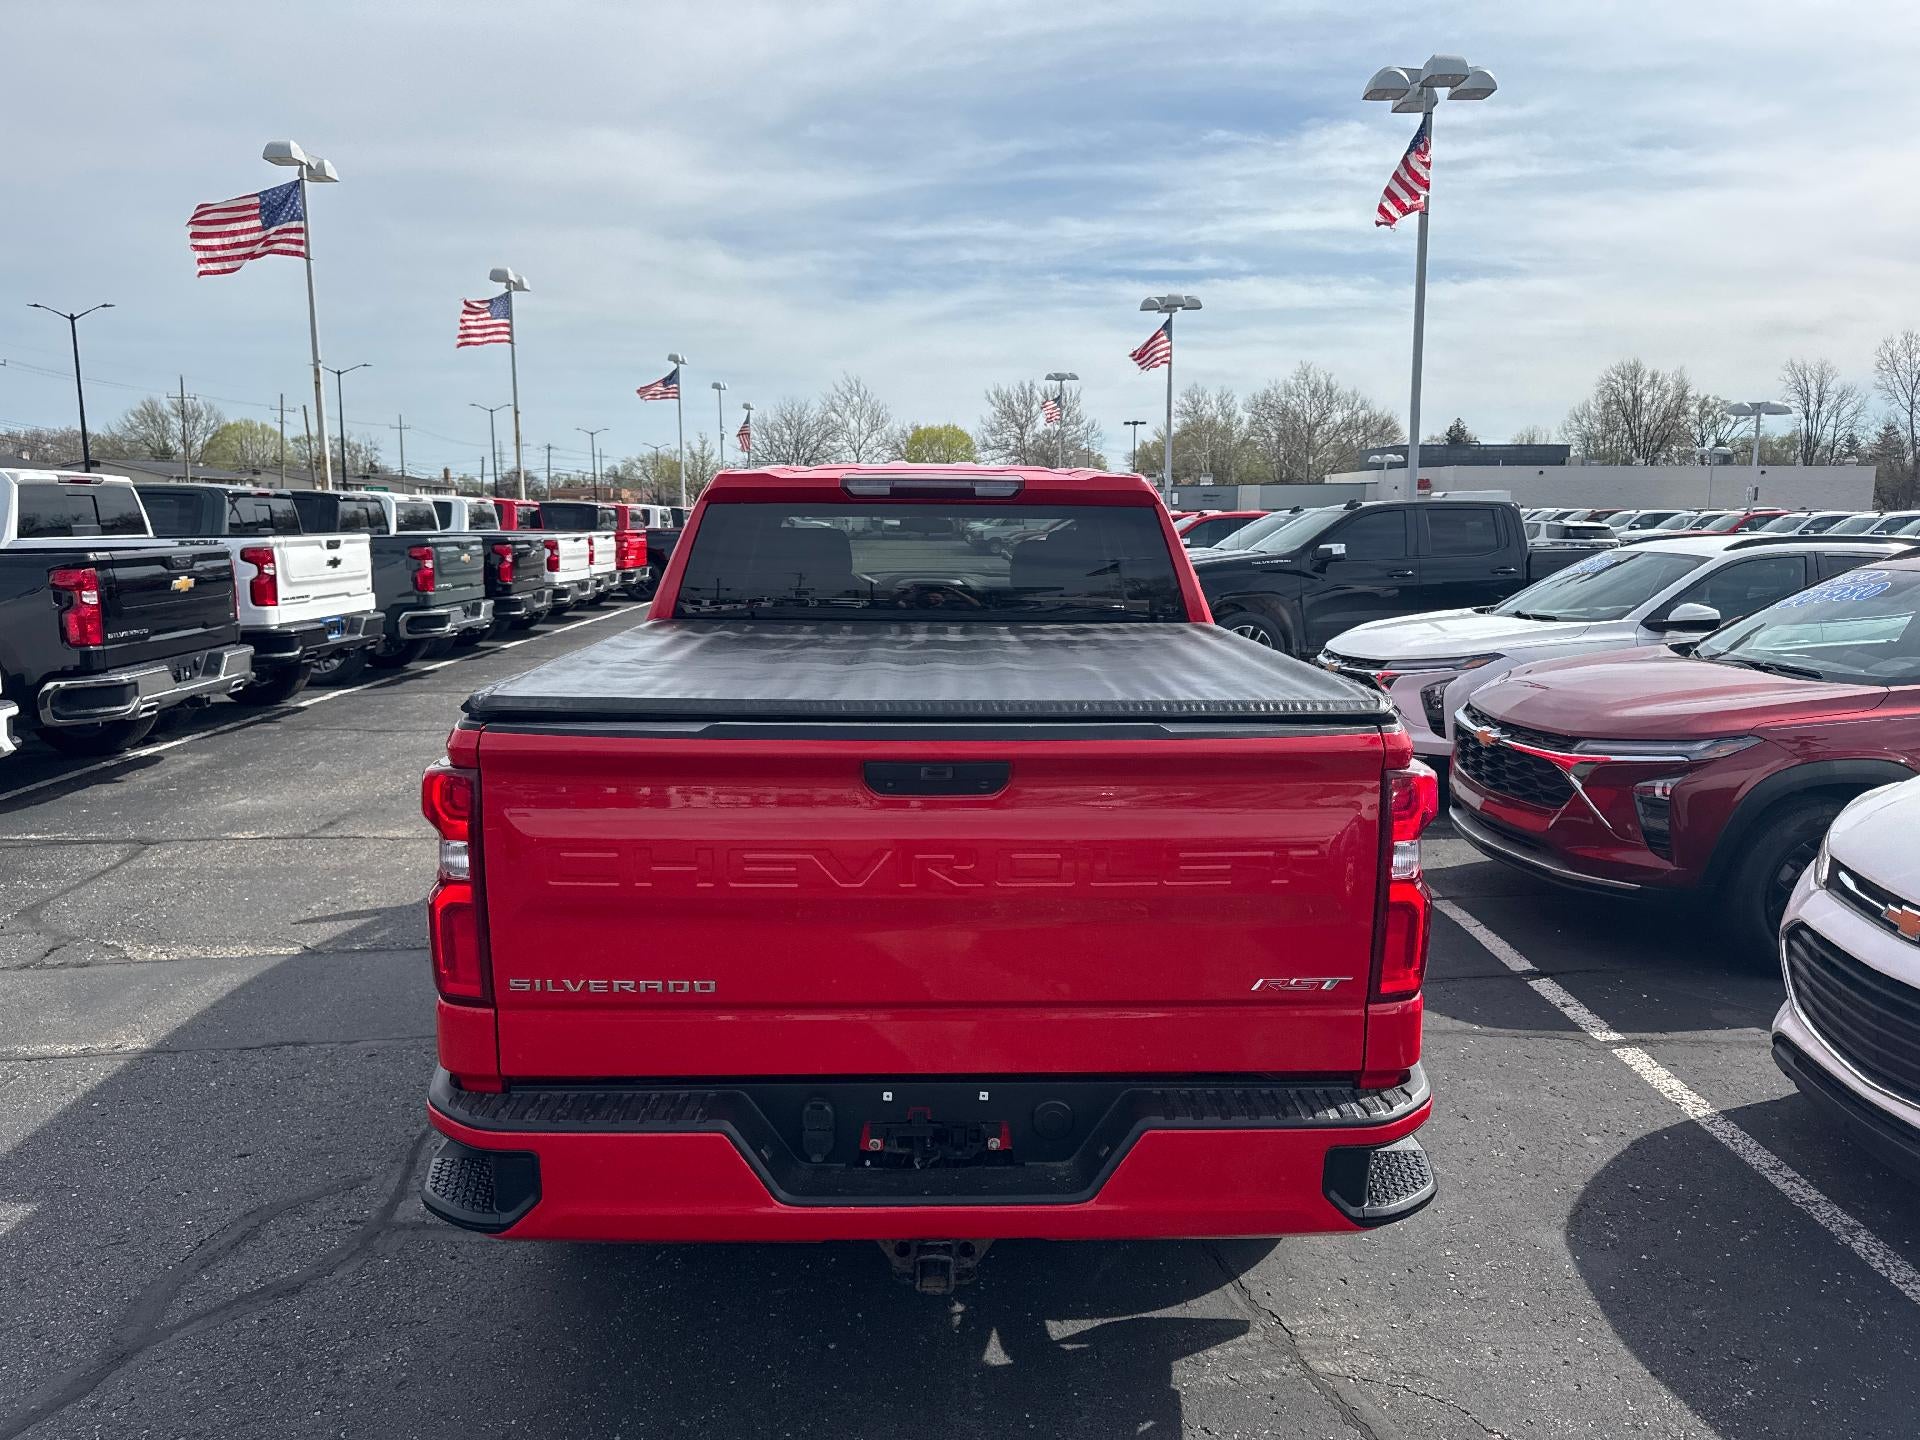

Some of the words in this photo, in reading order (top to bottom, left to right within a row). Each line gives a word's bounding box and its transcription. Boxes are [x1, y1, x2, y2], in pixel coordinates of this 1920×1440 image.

[547, 847, 1320, 888] CHEVROLET
[509, 978, 716, 993] SILVERADO
[1250, 976, 1353, 991] RST
